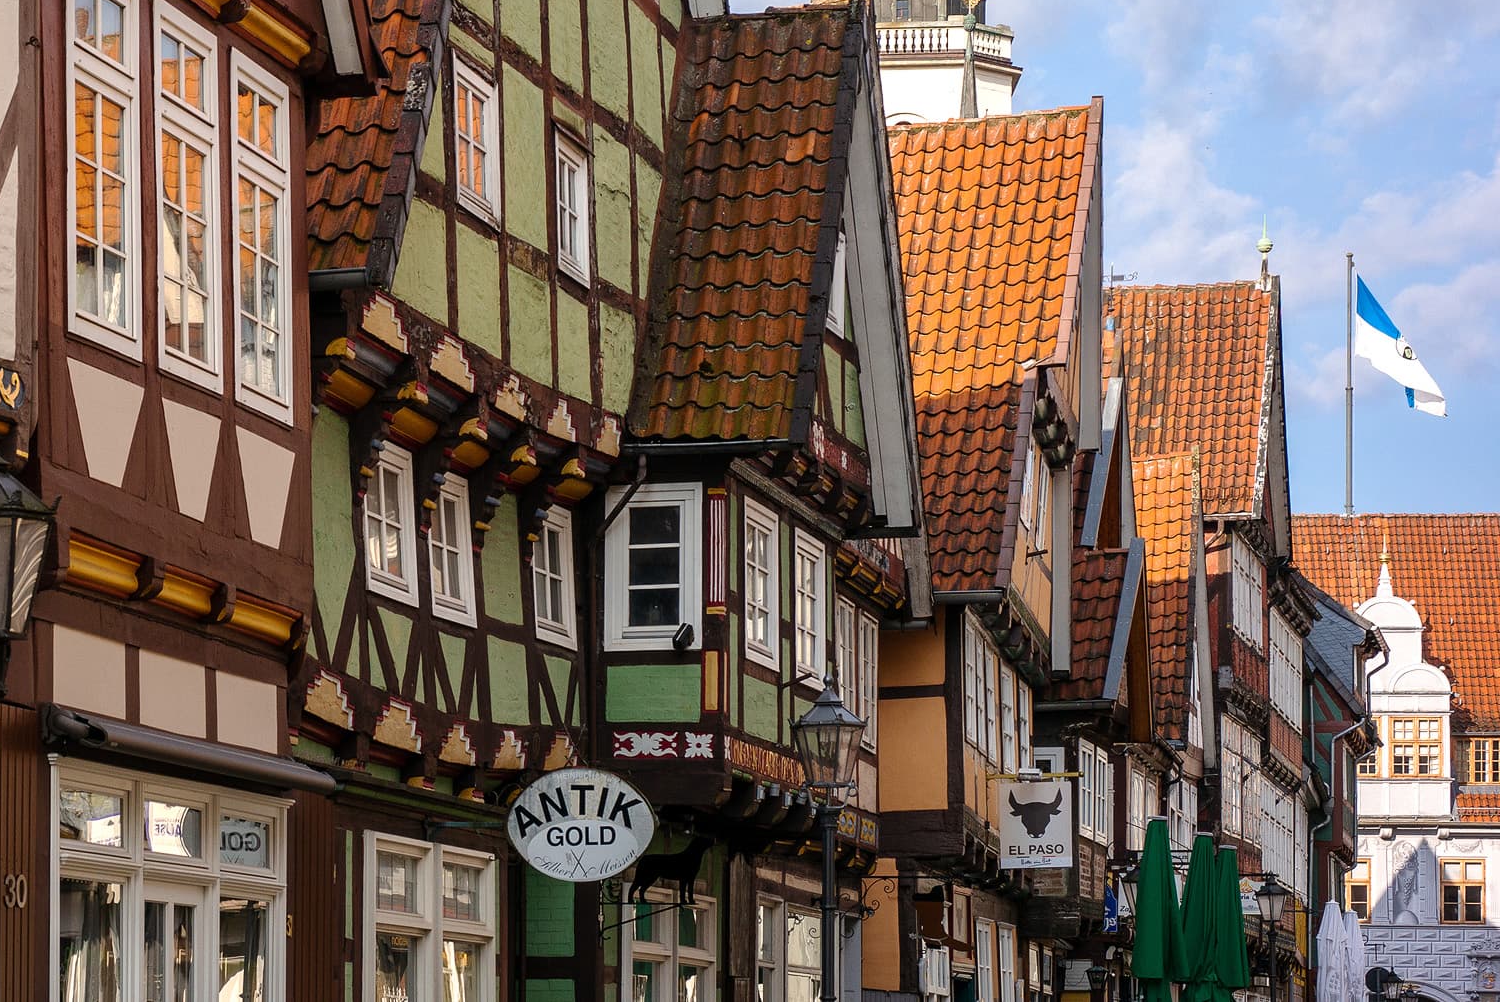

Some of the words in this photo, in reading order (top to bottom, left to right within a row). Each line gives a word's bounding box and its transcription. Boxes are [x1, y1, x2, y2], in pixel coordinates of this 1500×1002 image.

[514, 784, 642, 839] ANTIK
[546, 825, 616, 847] GOLD
[1008, 845, 1025, 855] EL
[1028, 844, 1064, 855] PASO
[4, 873, 28, 909] 30
